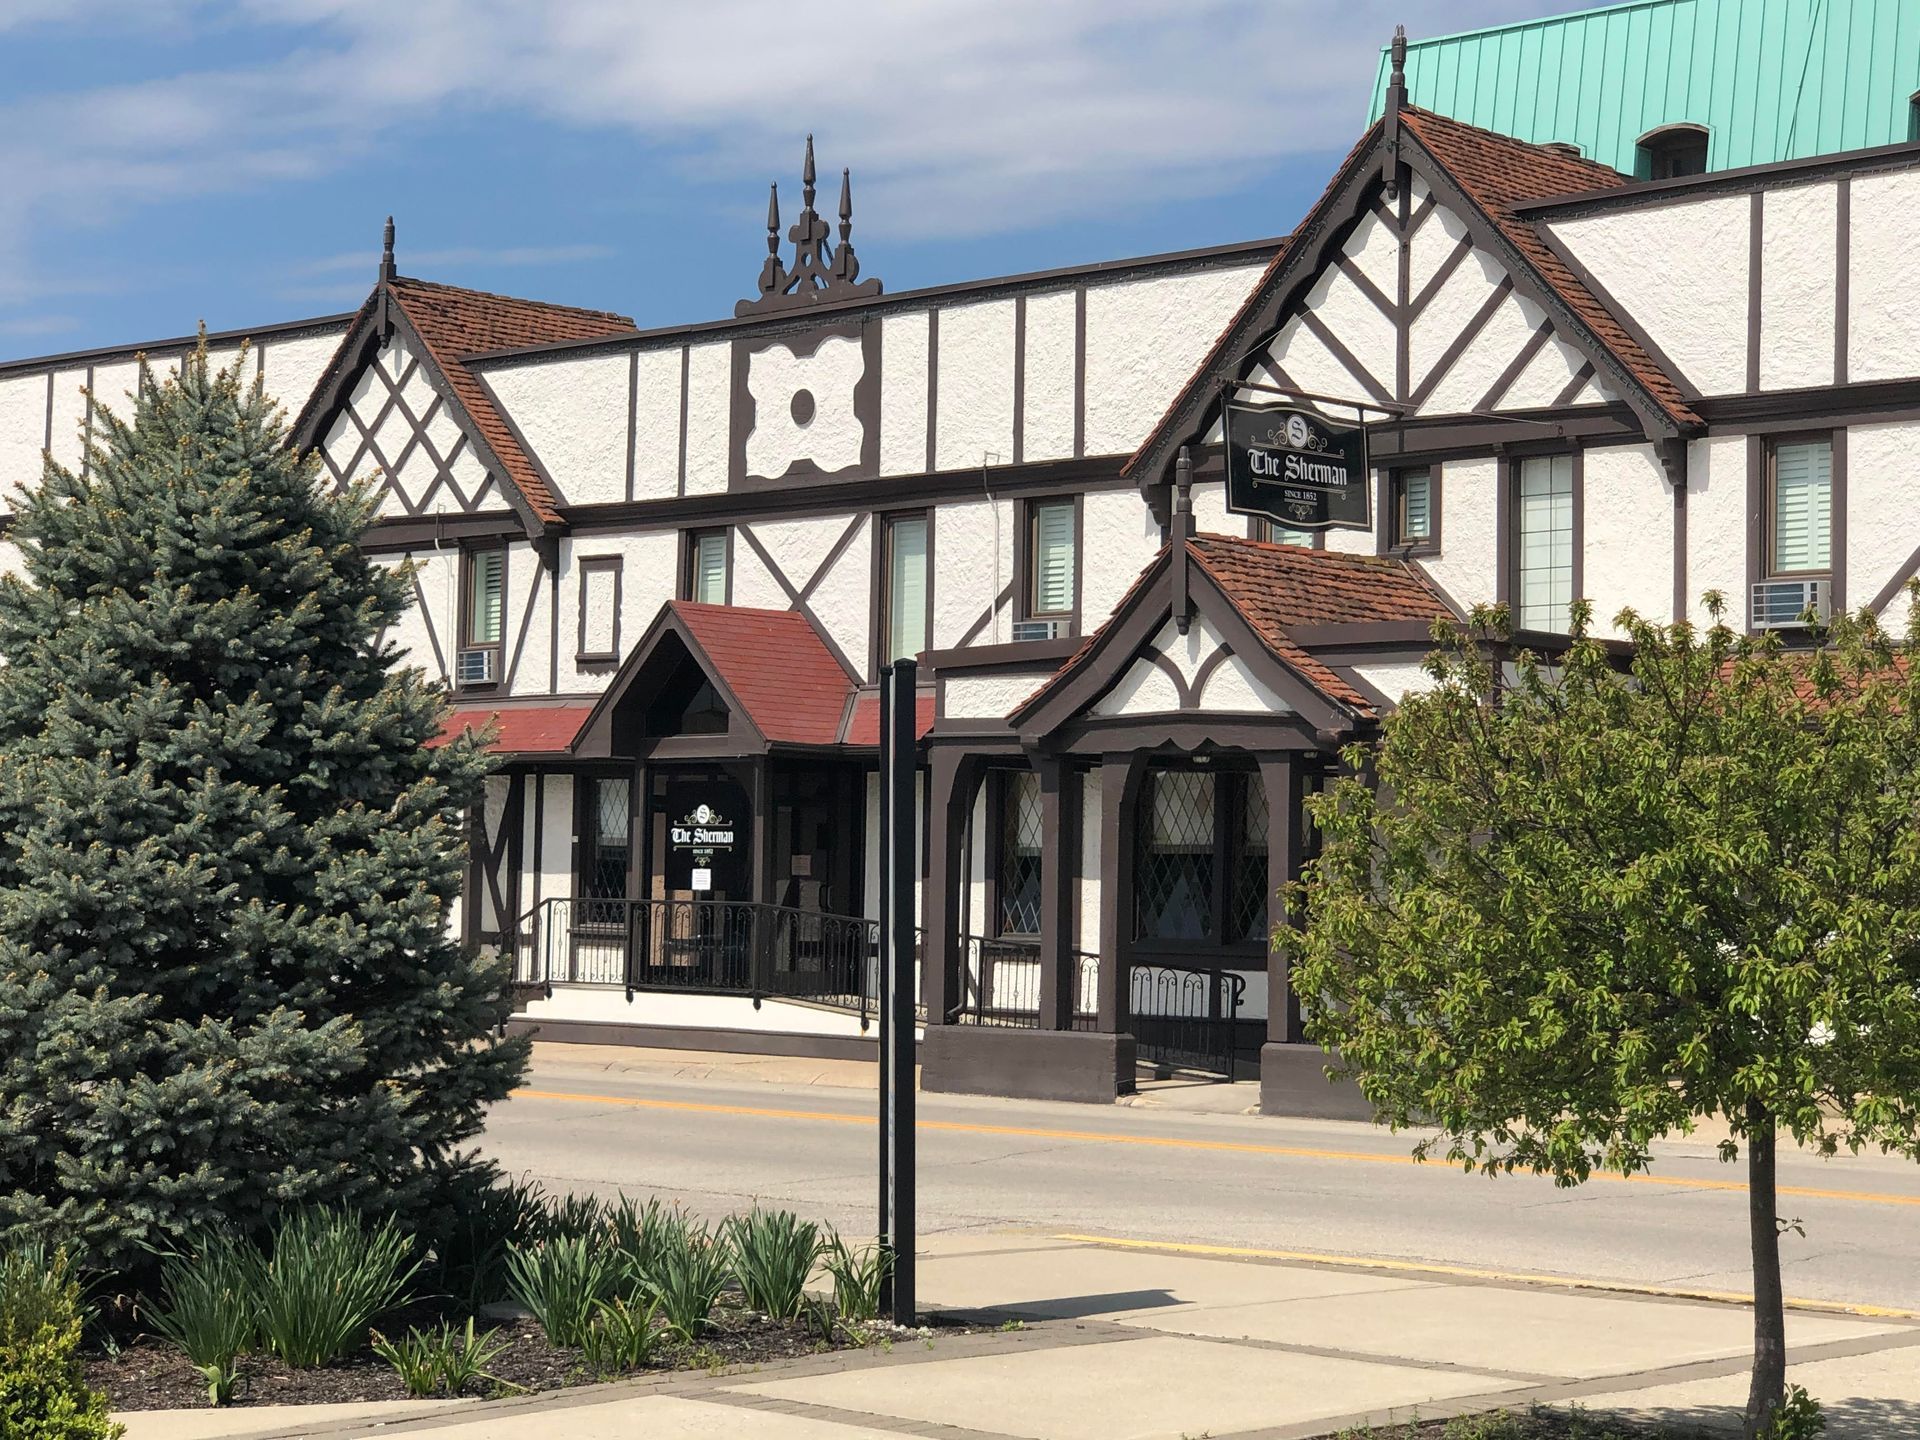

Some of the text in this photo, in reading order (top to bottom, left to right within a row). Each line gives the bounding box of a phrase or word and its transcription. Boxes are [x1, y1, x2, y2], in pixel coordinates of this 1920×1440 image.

[1247, 448, 1347, 485] The Sherman
[1284, 489, 1317, 501] SINCE 1852
[671, 827, 733, 845] The Sherman
